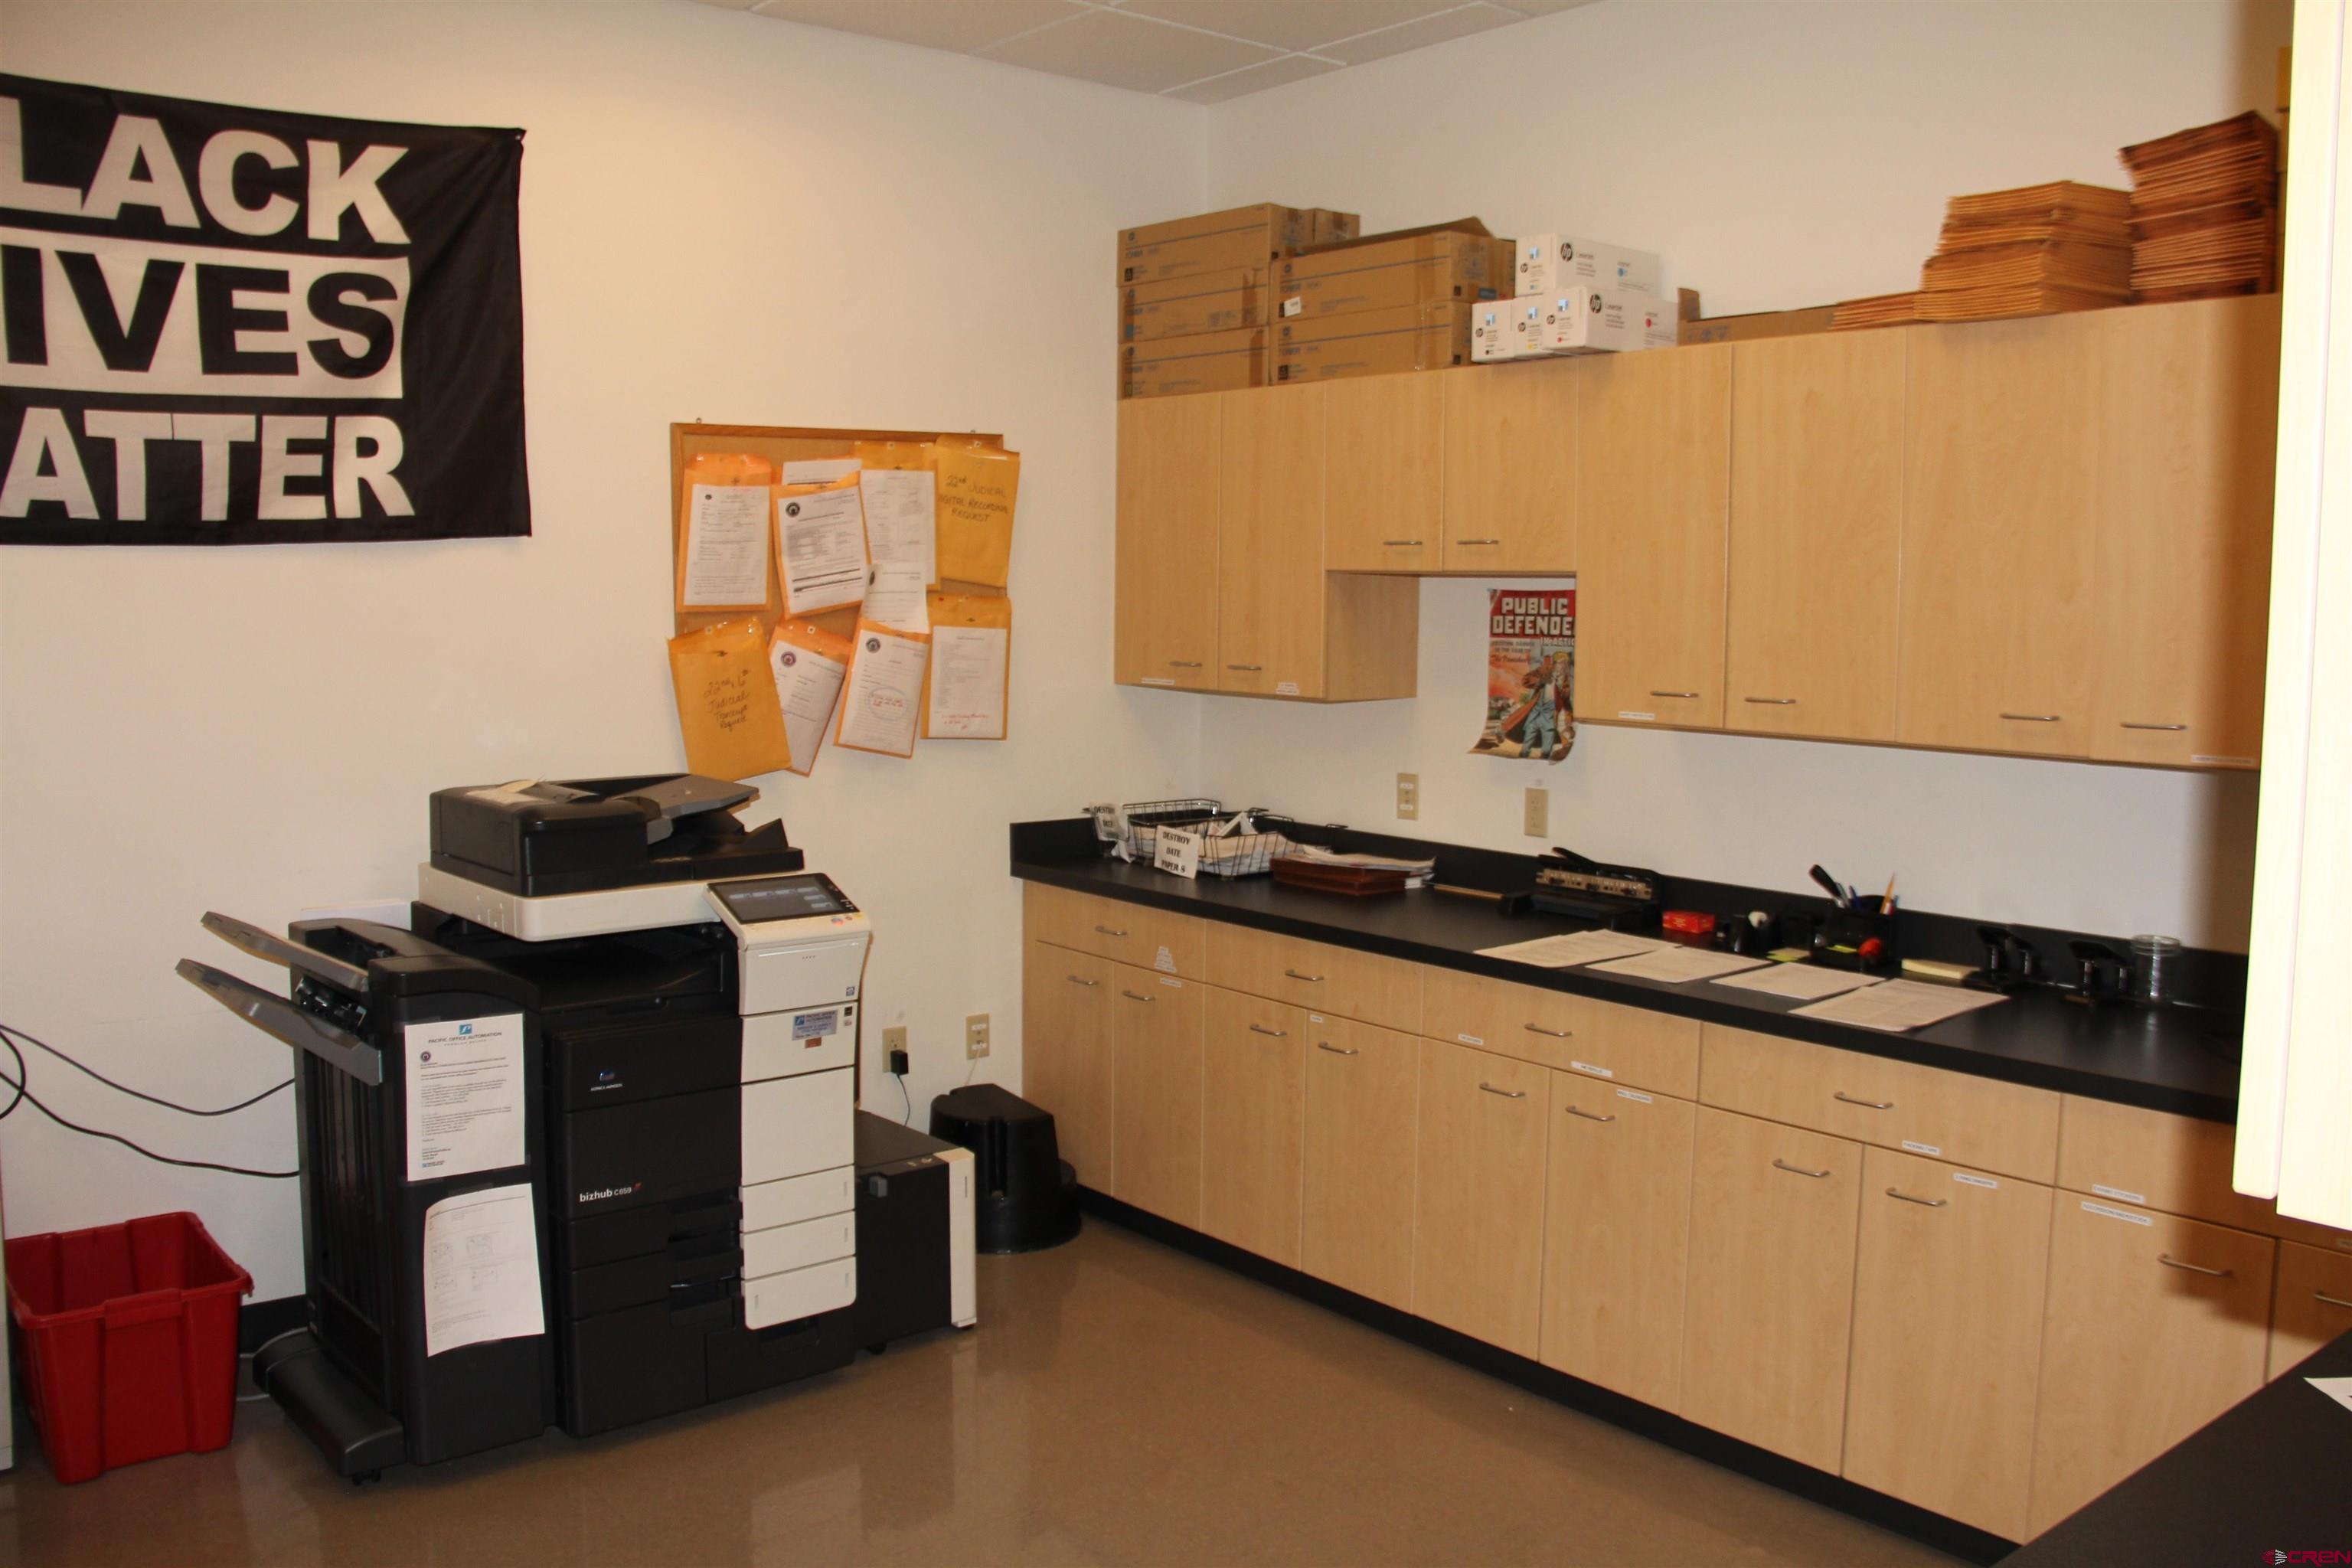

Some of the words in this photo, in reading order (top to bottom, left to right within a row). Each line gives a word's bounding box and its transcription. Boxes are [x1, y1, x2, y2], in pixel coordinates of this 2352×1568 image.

[1560, 243, 1573, 262] hp
[1589, 294, 1602, 314] hp
[0, 407, 415, 522] ATTER
[1501, 597, 1568, 615] PUBLIC
[1491, 616, 1575, 636] DEFENDE
[1162, 831, 1191, 845] DESTROY
[1165, 846, 1181, 858] DATE
[580, 1188, 612, 1202] bizhub
